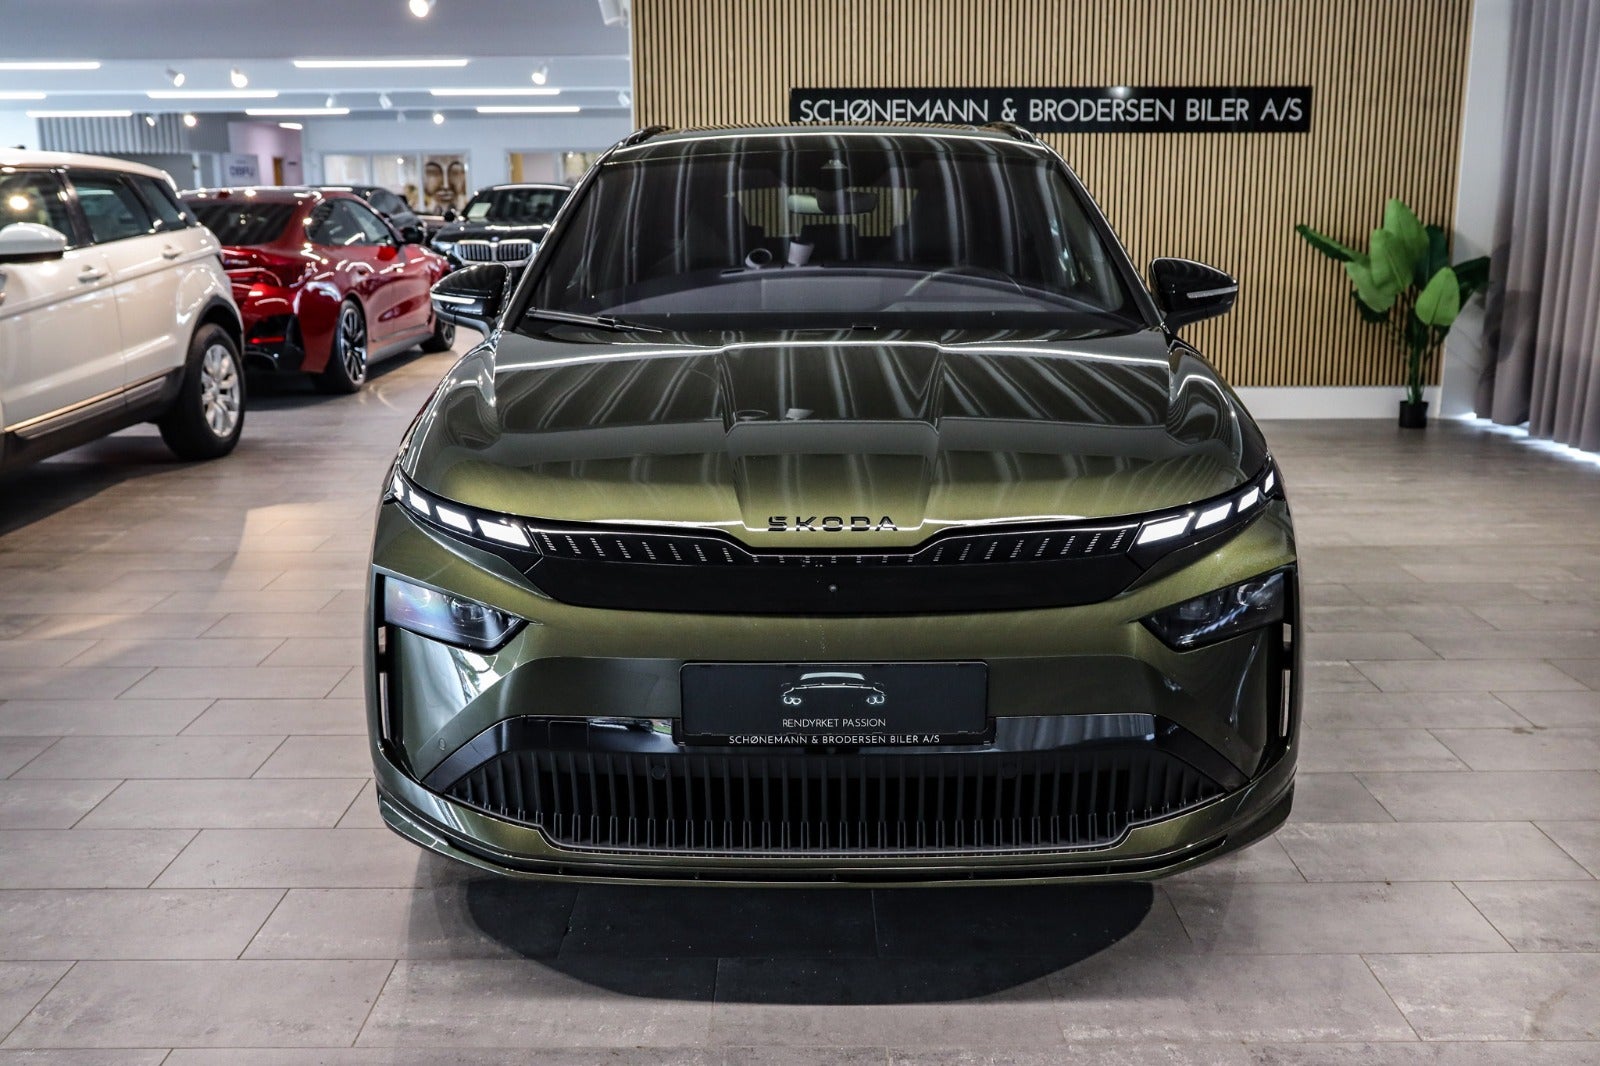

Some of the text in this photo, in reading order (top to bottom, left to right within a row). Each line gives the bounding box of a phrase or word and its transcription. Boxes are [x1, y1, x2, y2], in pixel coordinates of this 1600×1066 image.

[799, 97, 1304, 123] SCHØNEMANN & BRODERSEN BILER A/S
[782, 718, 887, 728] RENDYRKET PASSION
[728, 734, 940, 744] SCHØNEMANN & BRODERSEN BILER A/S
